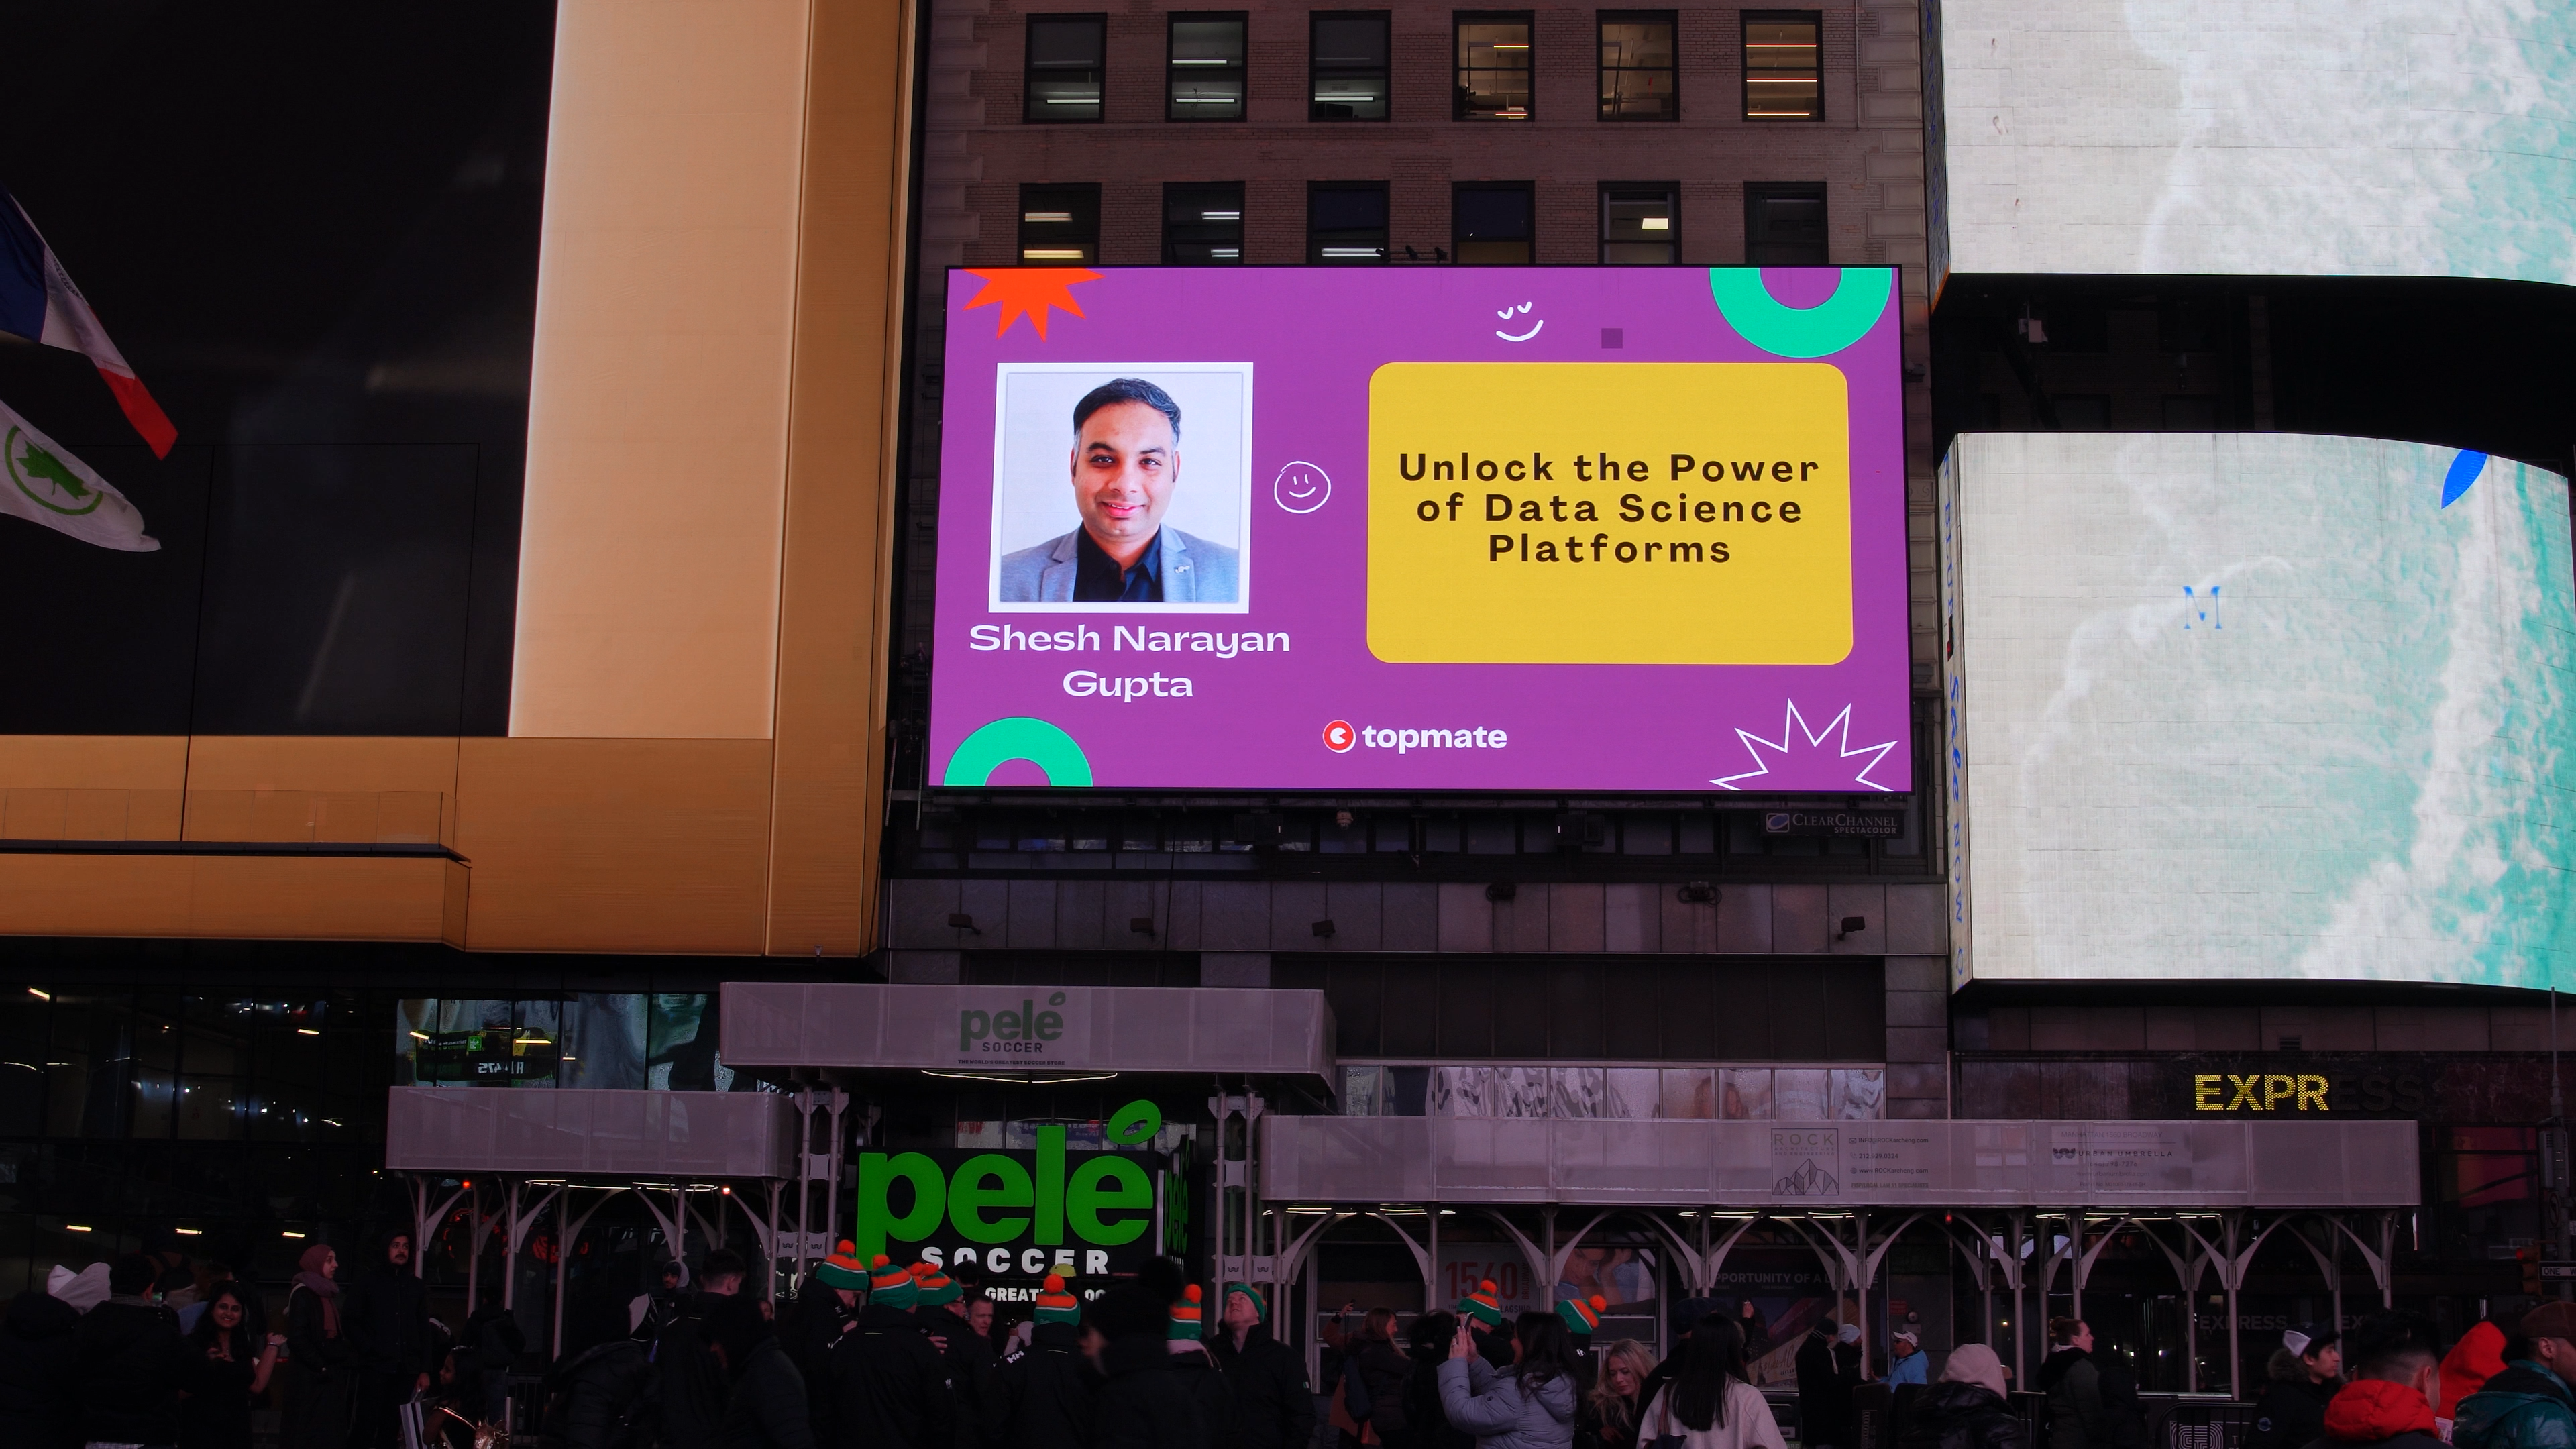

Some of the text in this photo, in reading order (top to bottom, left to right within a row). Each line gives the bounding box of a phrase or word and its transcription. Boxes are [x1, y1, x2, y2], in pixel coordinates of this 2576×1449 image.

[1399, 453, 1820, 482] Unlock the Power
[1417, 493, 1802, 523] of Data Science
[1489, 533, 1731, 564] Platforms
[2182, 586, 2221, 630] M
[969, 625, 1290, 659] Shesh Narayan
[1062, 670, 1193, 702] Gupta
[1362, 724, 1507, 754] topmate
[1949, 672, 1961, 804] Sale
[1953, 820, 1962, 924] NOW
[960, 991, 1066, 1052] pelé
[982, 1042, 1042, 1053] SOCCER
[2194, 1073, 2425, 1112] EXPRESS
[1774, 1134, 1835, 1146] ROCK
[855, 1099, 1162, 1271] pelé
[921, 1246, 1109, 1275] SOCCER
[2544, 1267, 2561, 1275] ONE
[1716, 1273, 1791, 1283] PPORTUNITY
[1794, 1273, 1811, 1283] OF
[1813, 1273, 1822, 1283] A
